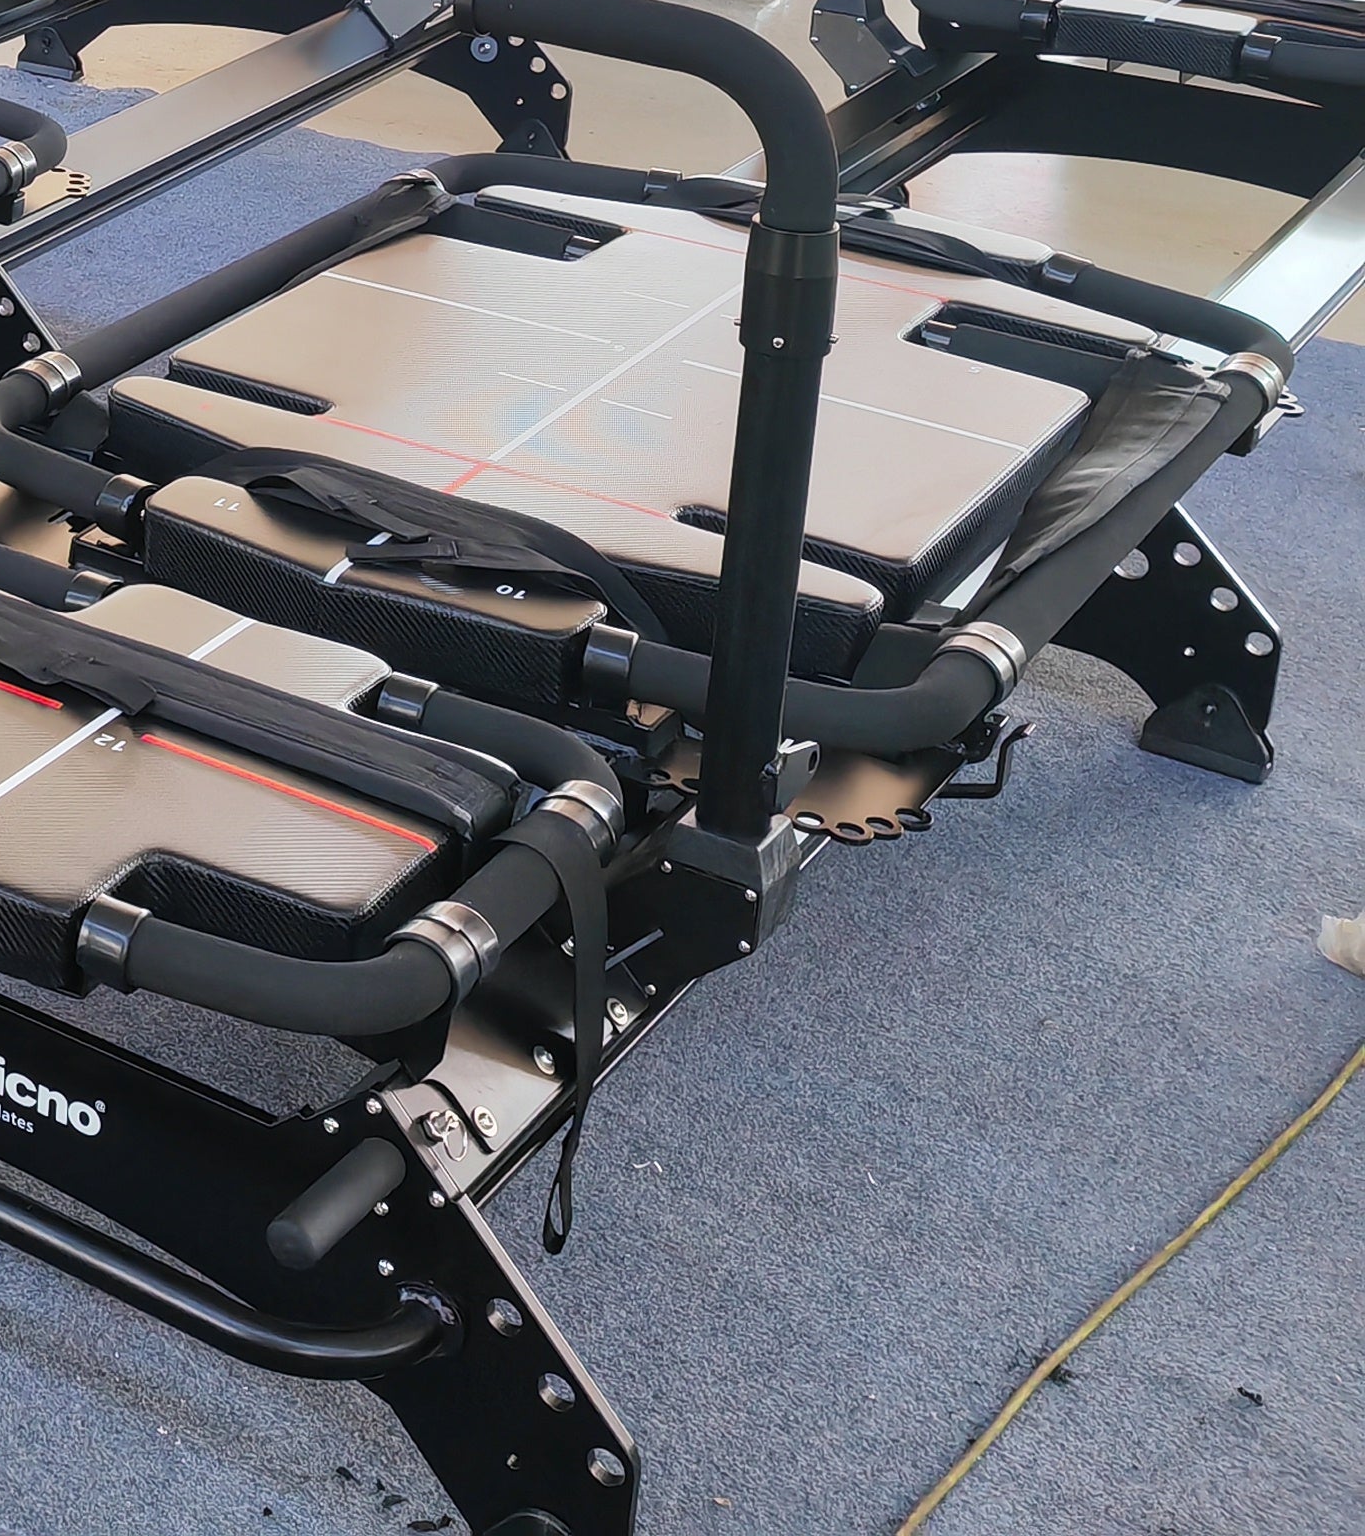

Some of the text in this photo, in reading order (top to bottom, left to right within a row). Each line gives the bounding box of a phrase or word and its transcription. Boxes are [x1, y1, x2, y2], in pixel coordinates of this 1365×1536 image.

[214, 498, 241, 512] 11
[496, 584, 526, 600] 10
[93, 733, 127, 752] 12
